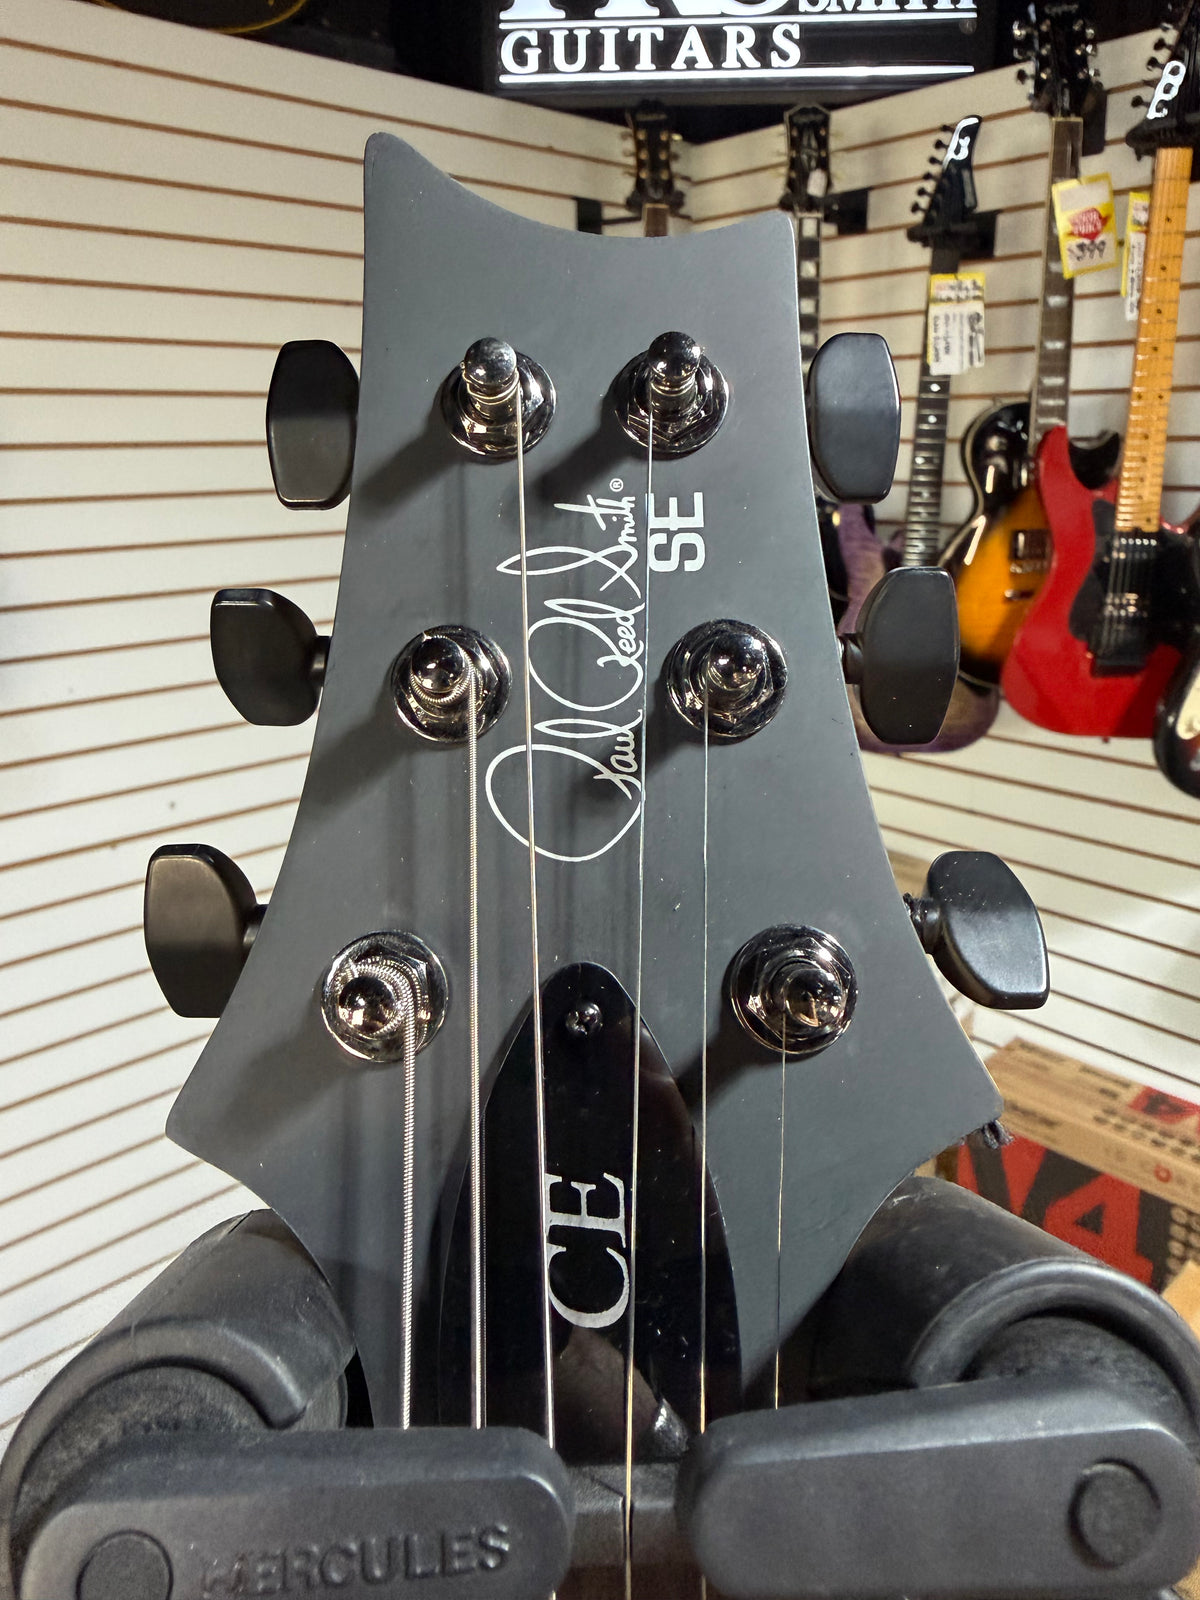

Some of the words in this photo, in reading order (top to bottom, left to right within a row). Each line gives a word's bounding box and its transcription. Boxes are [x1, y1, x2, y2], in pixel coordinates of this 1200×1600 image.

[500, 23, 801, 74] GUITARS
[645, 491, 705, 572] SE
[528, 598, 645, 712] Reed
[485, 709, 645, 862] Paul
[543, 1172, 630, 1328] CE
